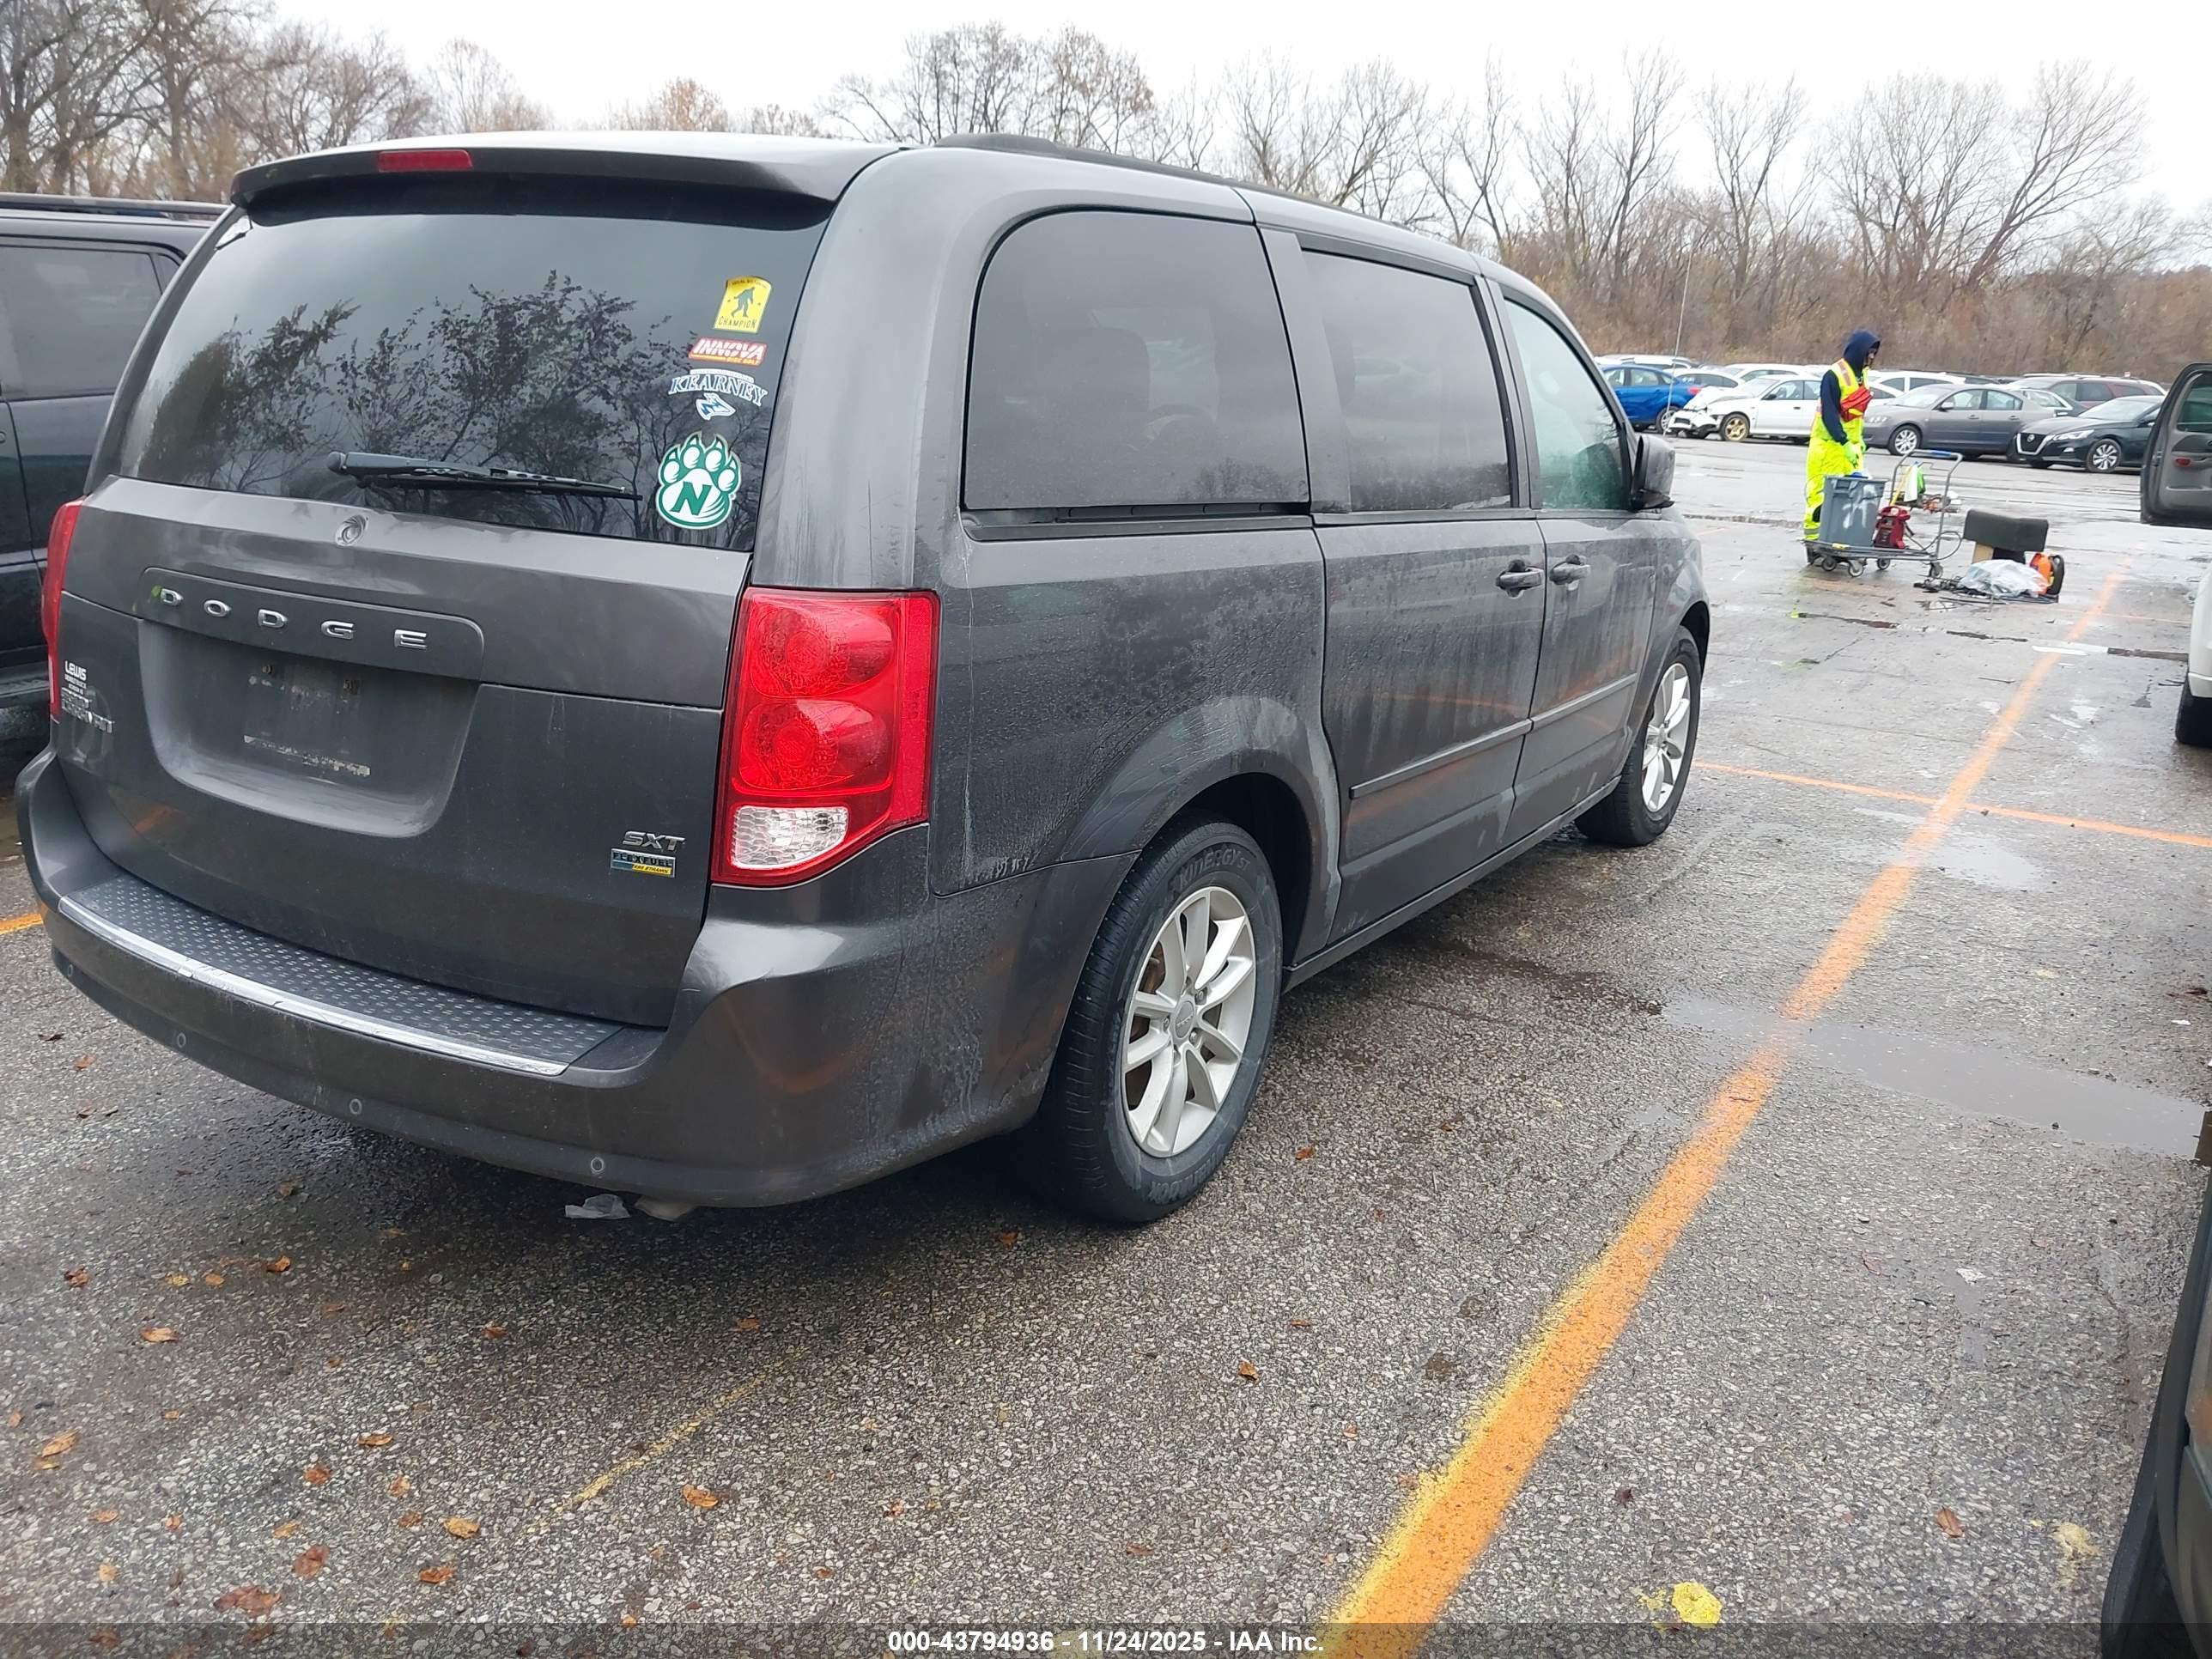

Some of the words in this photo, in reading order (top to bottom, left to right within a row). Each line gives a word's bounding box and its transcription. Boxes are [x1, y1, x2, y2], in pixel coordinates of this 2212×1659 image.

[718, 315, 758, 329] CHAMPION
[693, 337, 766, 360] INNOVA
[668, 374, 768, 407] KEARNEY
[670, 482, 713, 516] N
[160, 587, 428, 651] DODGE
[622, 830, 686, 852] SXT
